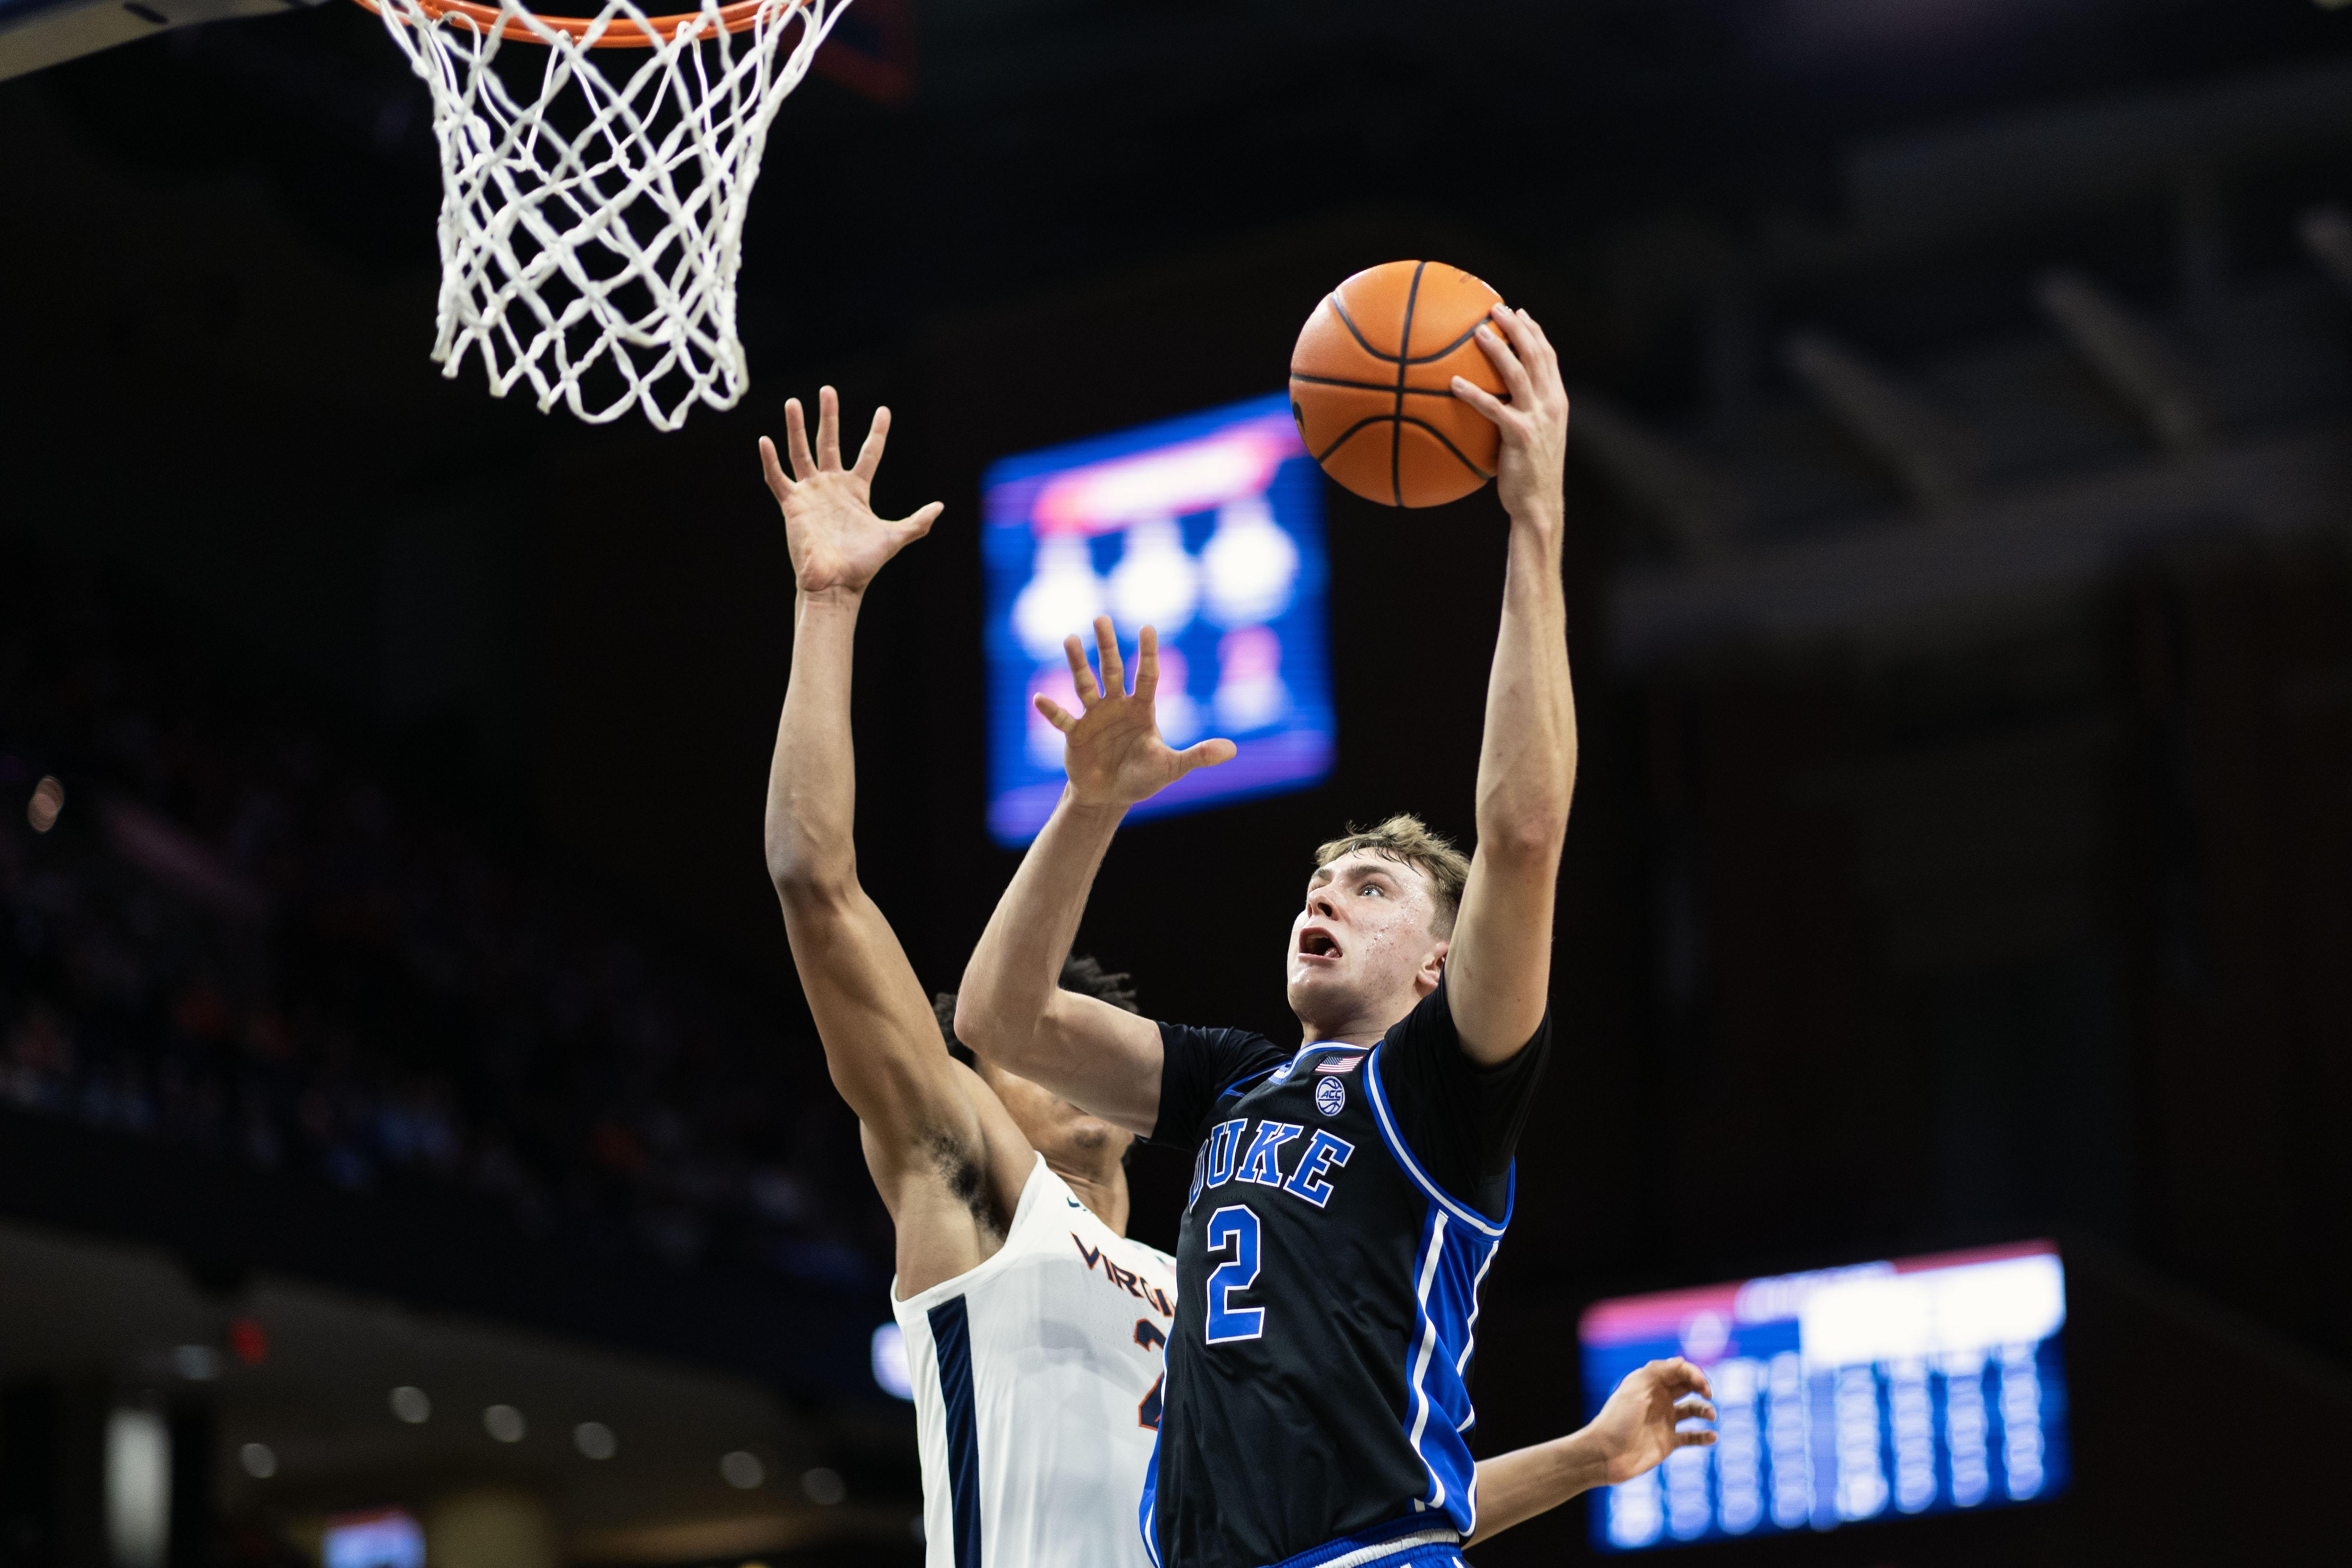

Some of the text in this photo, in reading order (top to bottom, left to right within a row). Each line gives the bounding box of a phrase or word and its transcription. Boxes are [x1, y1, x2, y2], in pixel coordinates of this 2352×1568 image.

[1321, 1090, 1342, 1099] ACC
[1189, 1117, 1355, 1214] DUKE
[1070, 1230, 1176, 1317] VIRGI
[1205, 1204, 1265, 1345] 2
